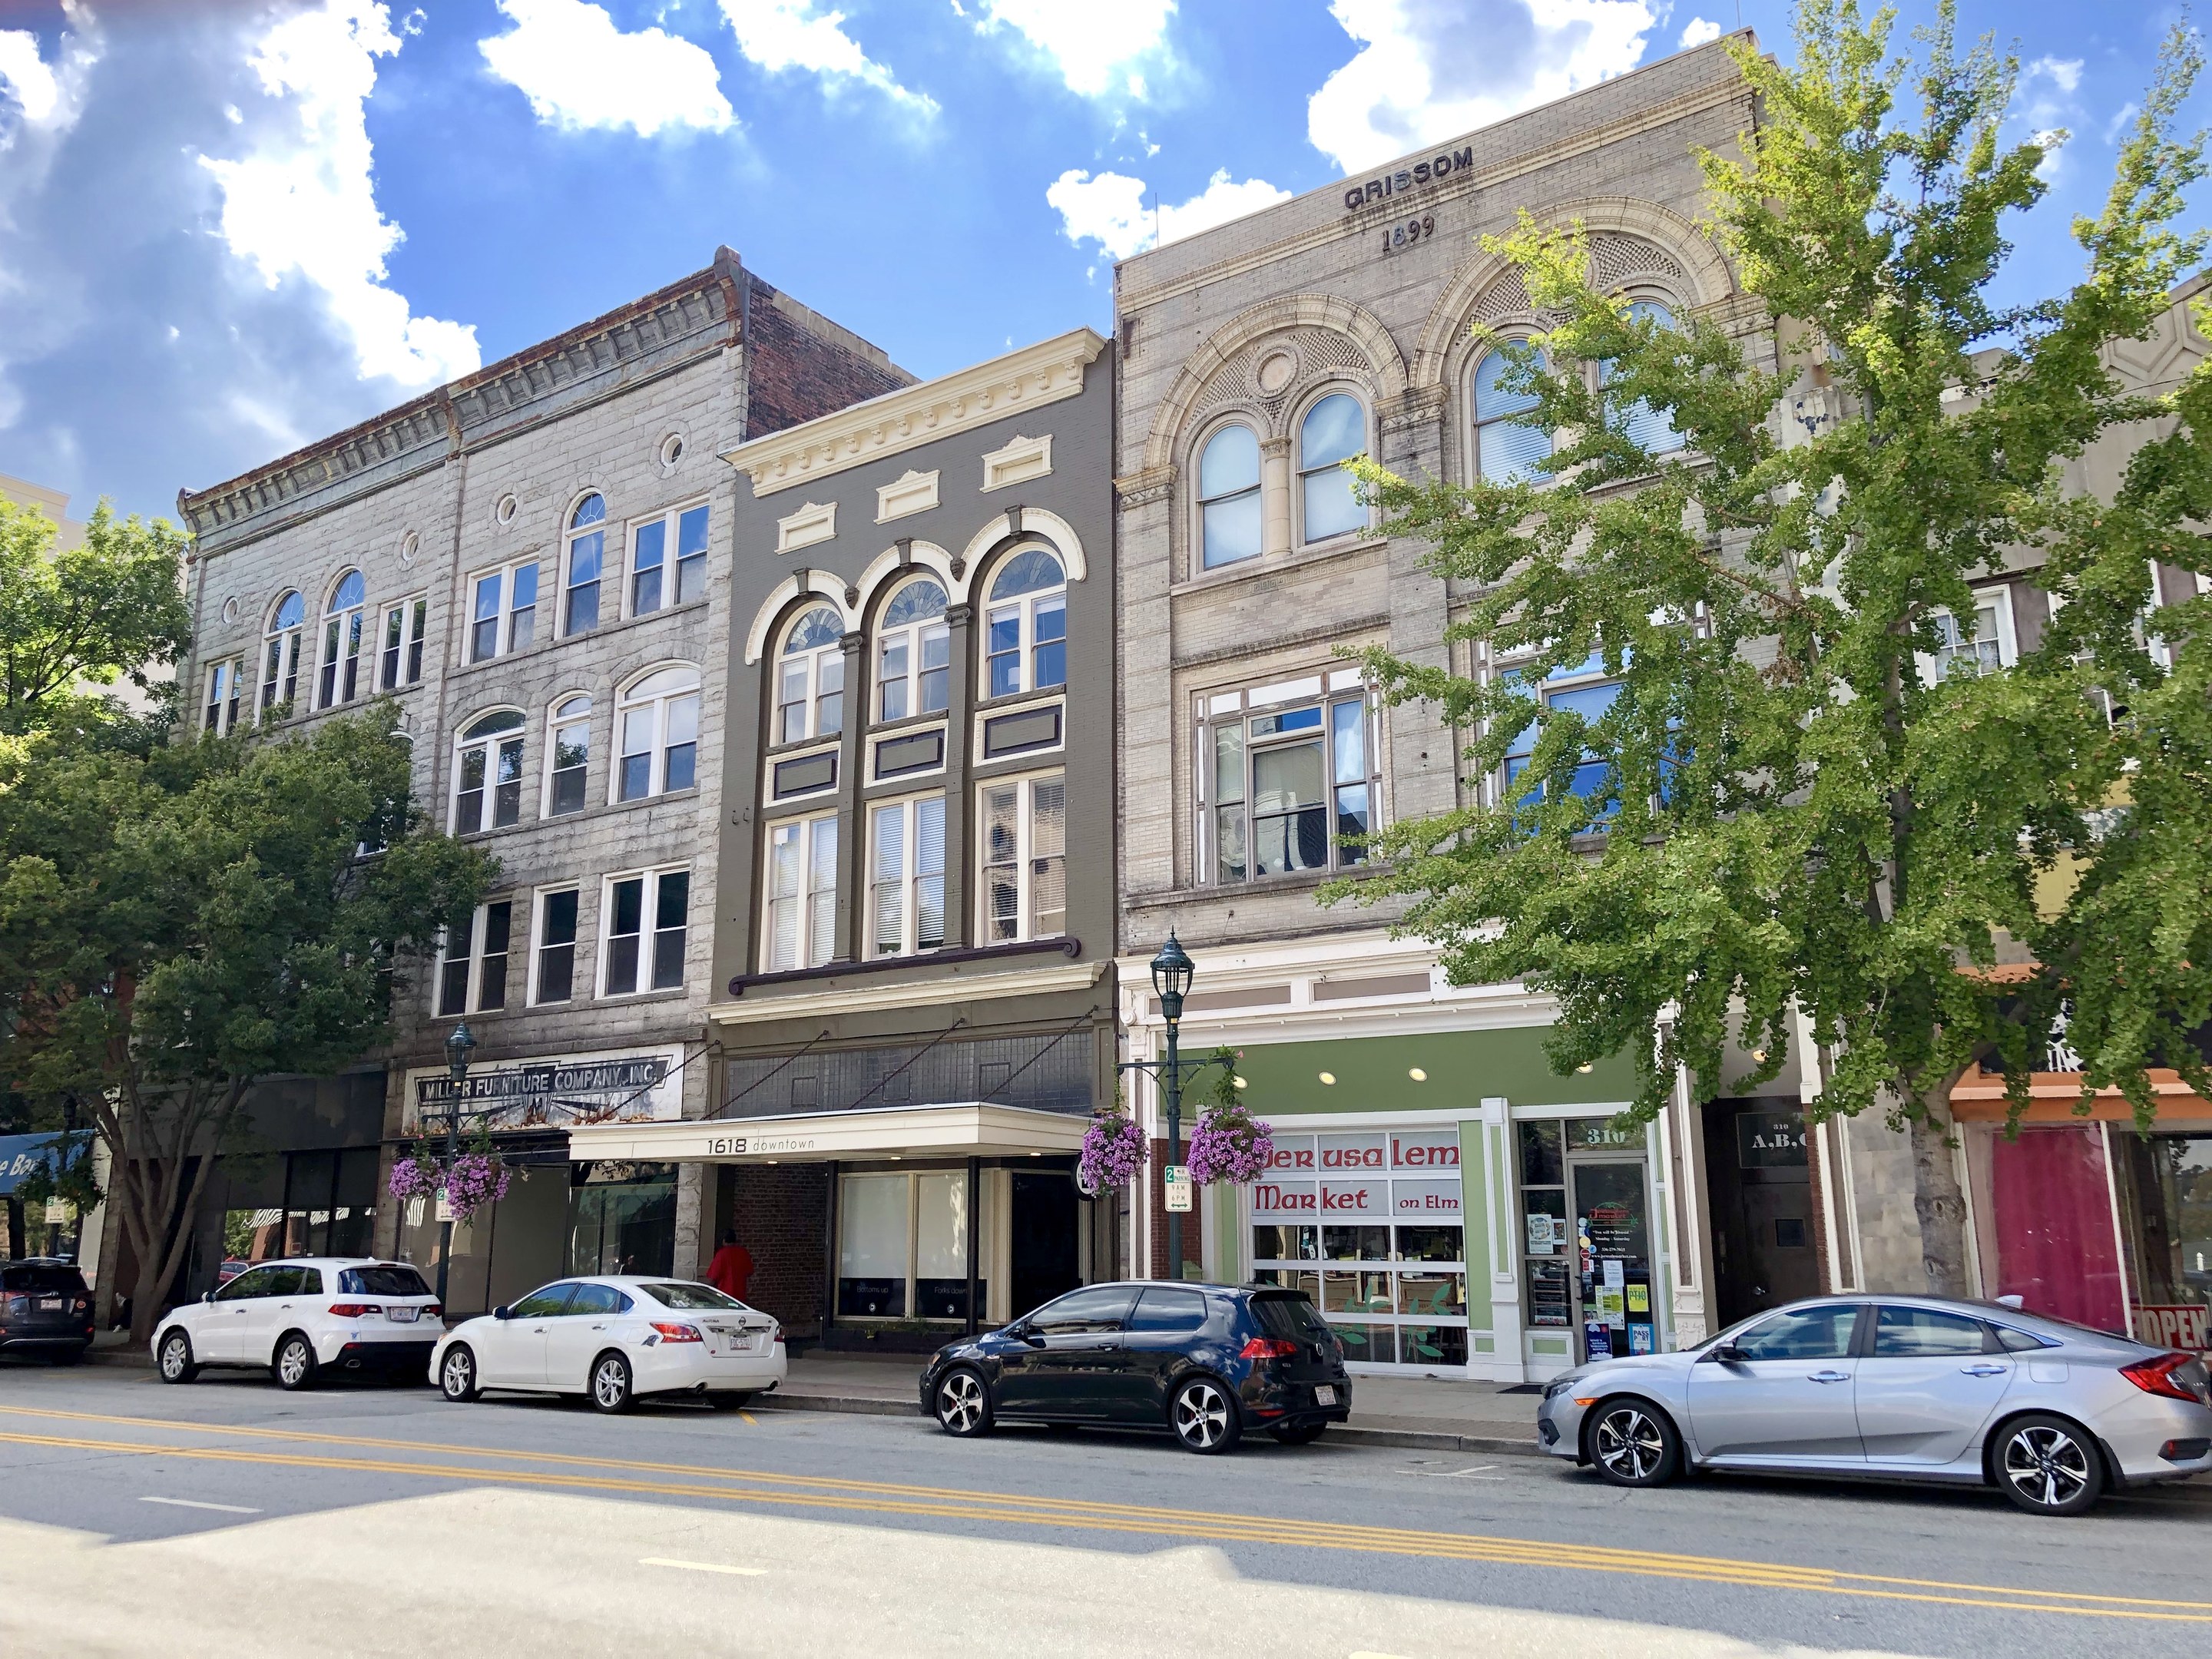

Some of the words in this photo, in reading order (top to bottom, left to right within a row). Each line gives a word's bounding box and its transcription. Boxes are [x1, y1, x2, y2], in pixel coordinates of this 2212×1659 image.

[1344, 146, 1473, 209] GRISSOM
[1382, 215, 1434, 252] 1899
[475, 1073, 550, 1096] FURNITURE
[708, 1138, 747, 1154] 1618
[753, 1137, 814, 1151] downtown
[1587, 1128, 1625, 1144] 310
[1167, 1169, 1173, 1181] 2
[438, 1190, 444, 1199] 2
[1255, 1185, 1369, 1210] Market
[1399, 1199, 1419, 1208] on
[1425, 1195, 1459, 1209] Elm
